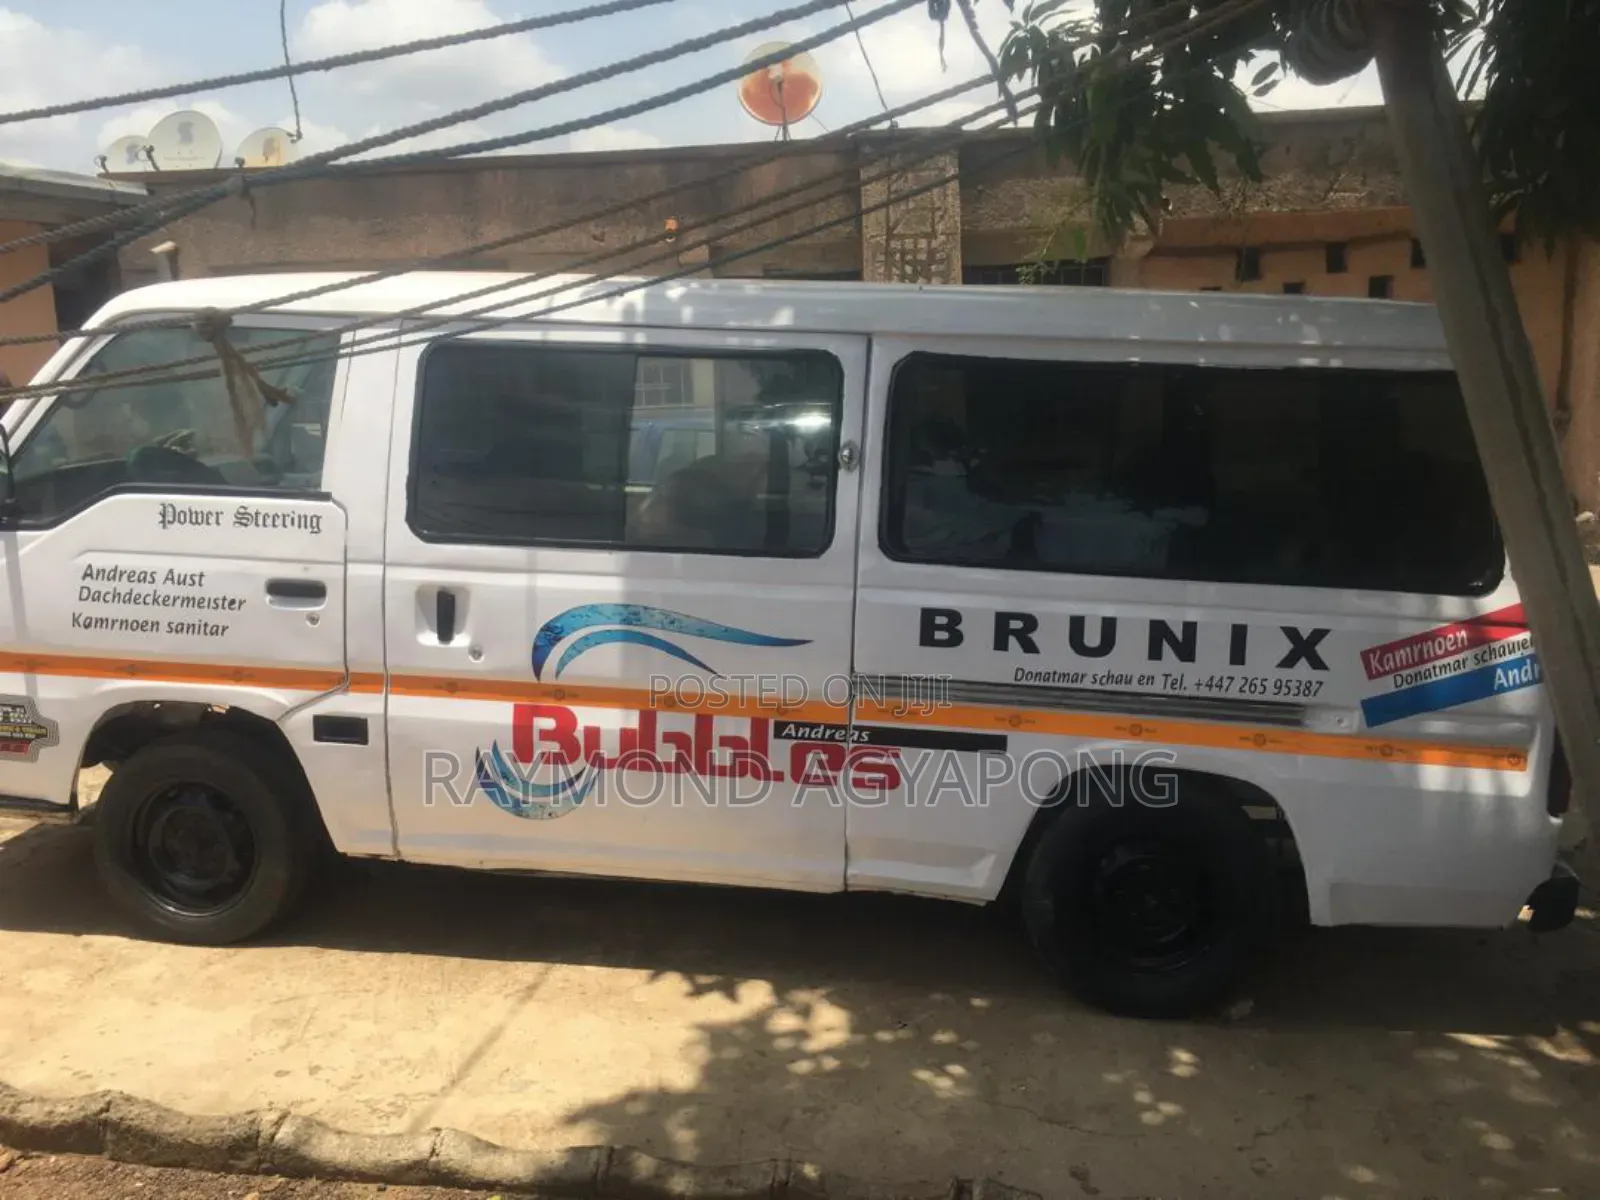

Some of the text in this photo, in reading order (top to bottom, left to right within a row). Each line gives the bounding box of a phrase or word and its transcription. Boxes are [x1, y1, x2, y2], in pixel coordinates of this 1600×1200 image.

[157, 503, 322, 534] Power Steering
[81, 564, 206, 588] Andreas Aust
[78, 585, 246, 612] Dachdeckermeister
[71, 612, 230, 638] Kamrnoen sanitar
[919, 607, 1332, 671] BRUNIX
[1369, 629, 1468, 675] Kamrnoen
[1014, 667, 1087, 685] Donatmar
[1161, 673, 1188, 692] Tel.
[1194, 675, 1235, 693] +447
[1239, 676, 1267, 696] 265
[1273, 679, 1325, 698] 95387
[1393, 657, 1468, 689] Donatmar
[781, 722, 871, 743] Andreas
